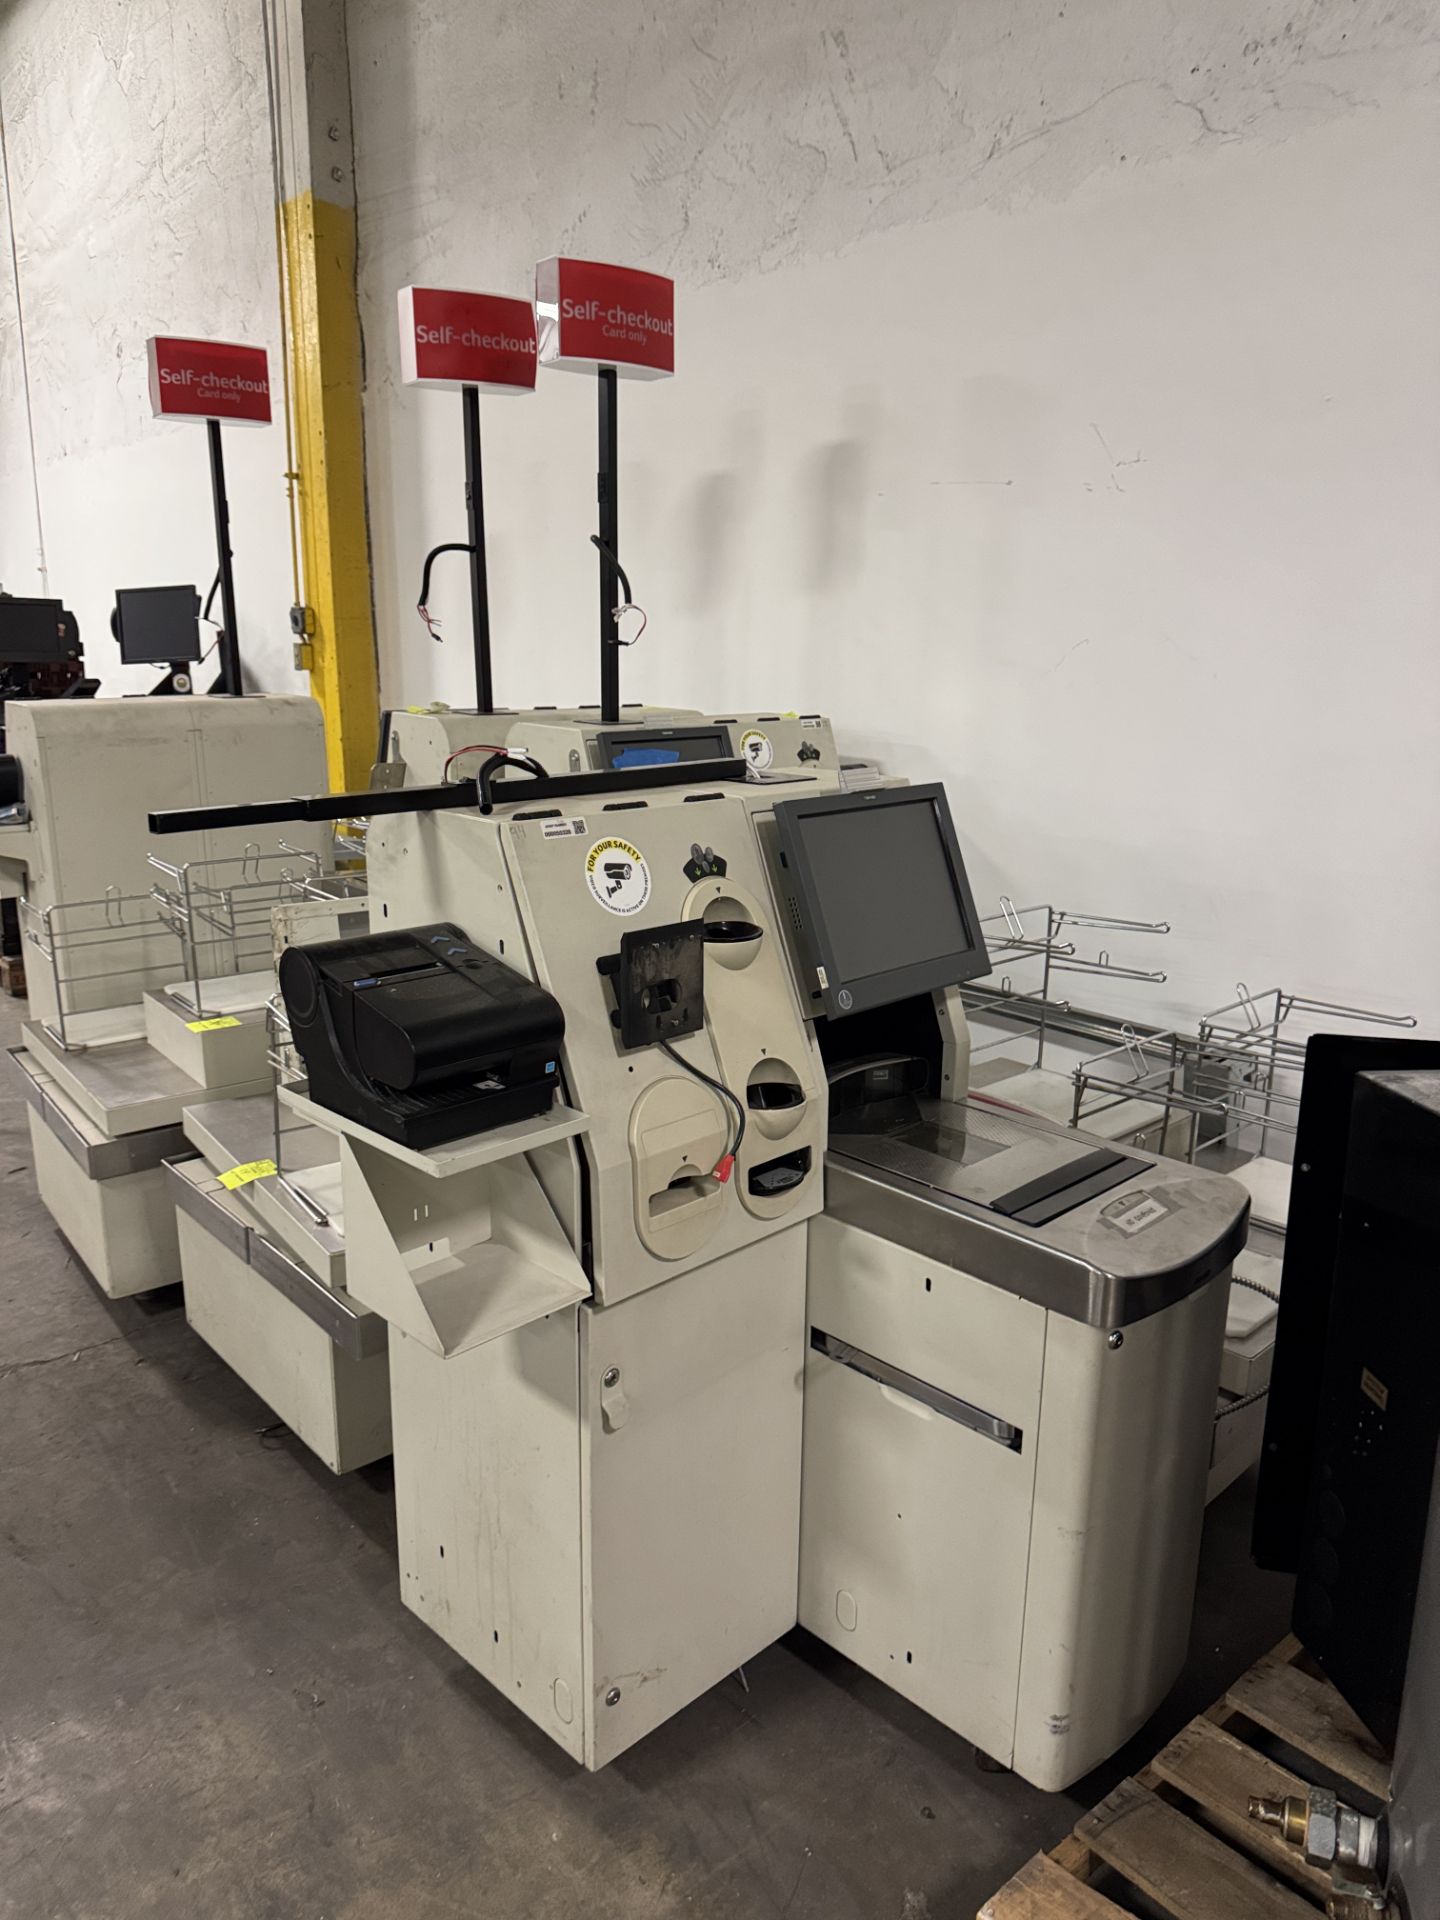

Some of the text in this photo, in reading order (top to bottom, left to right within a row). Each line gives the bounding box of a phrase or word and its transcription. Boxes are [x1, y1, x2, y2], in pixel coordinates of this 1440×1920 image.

[561, 298, 673, 337] Self-checkout
[416, 324, 536, 355] Self-checkout
[602, 325, 647, 346] Card only
[160, 368, 269, 394] Self-checkout
[196, 387, 241, 404] Card only
[587, 840, 641, 872] FOR YOUR SAFETY
